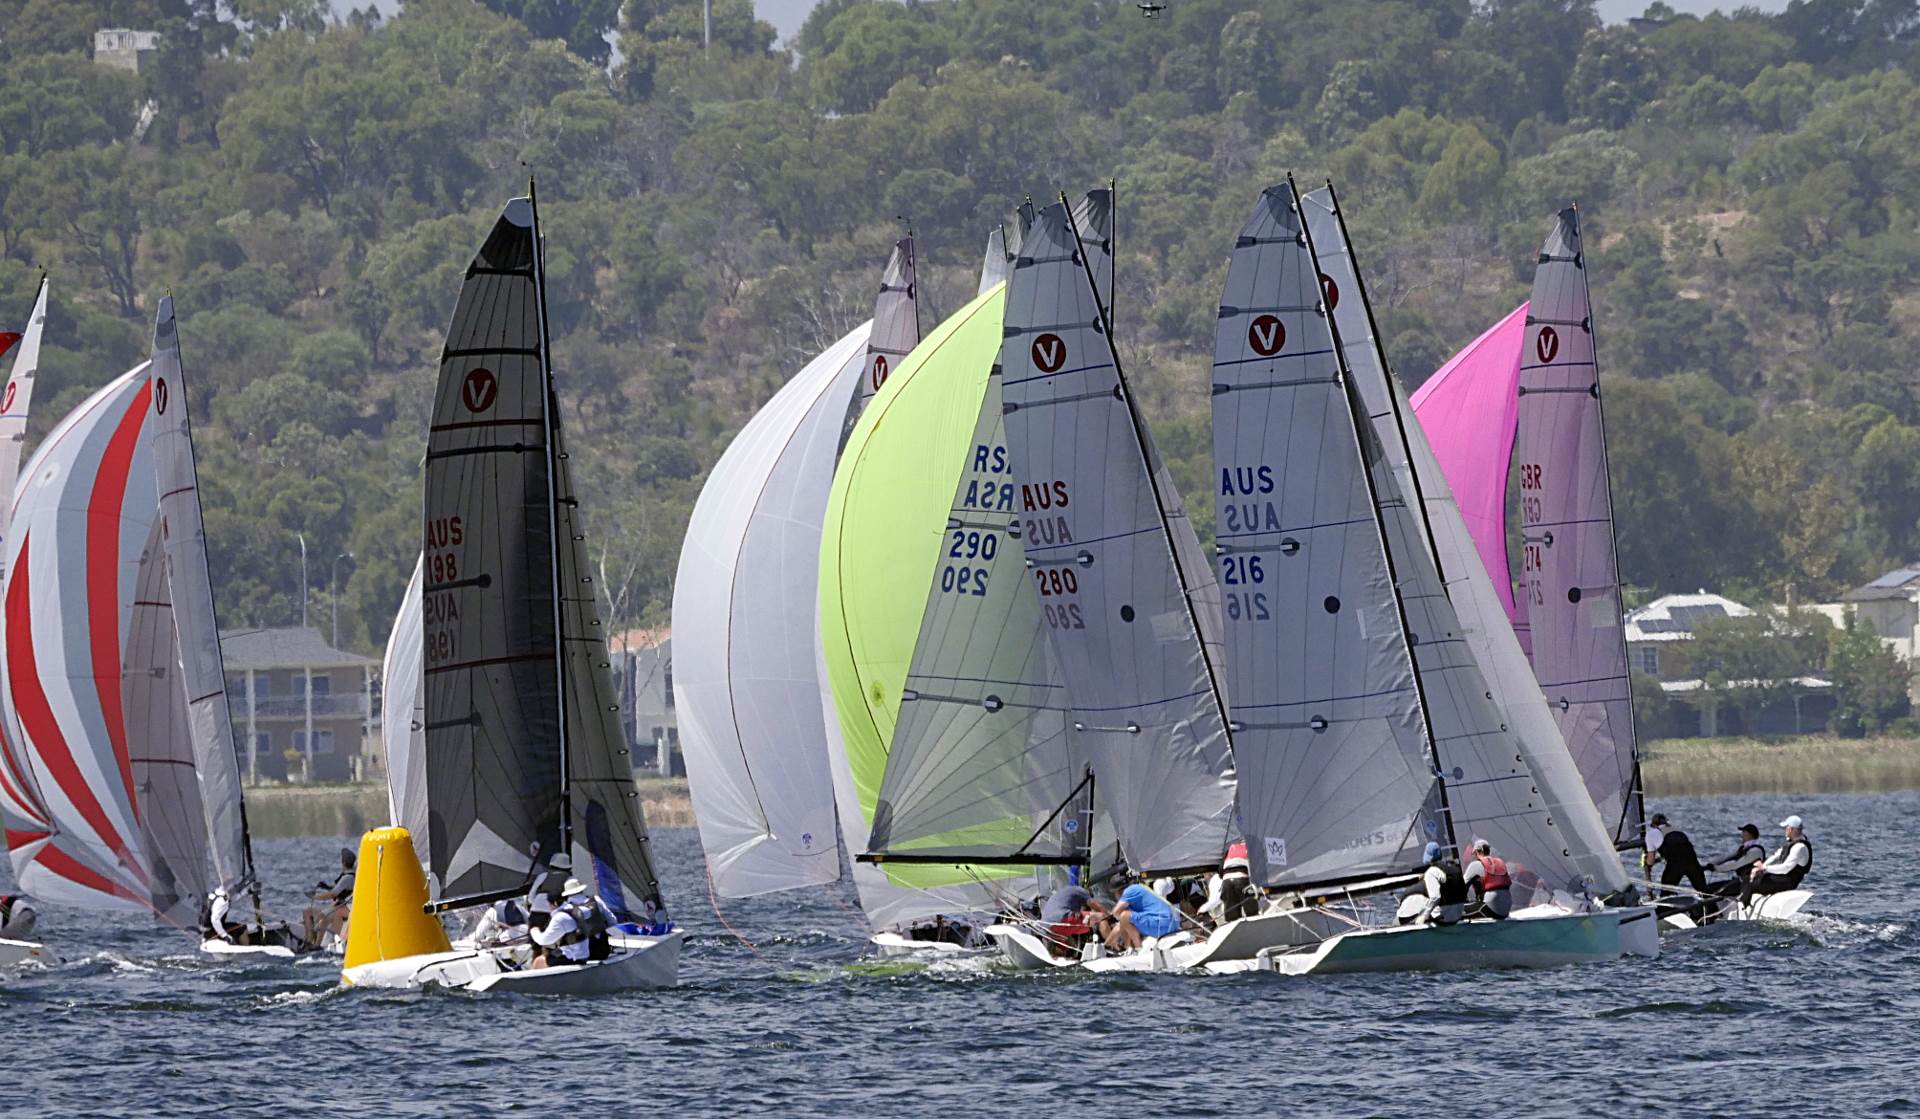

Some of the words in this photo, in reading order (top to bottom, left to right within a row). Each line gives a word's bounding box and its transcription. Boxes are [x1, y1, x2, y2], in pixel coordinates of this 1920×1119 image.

[973, 445, 1012, 474] RS
[1022, 480, 1069, 512] AUS
[1221, 465, 1275, 496] AUS
[427, 516, 463, 550] AUS
[949, 530, 997, 561] 290
[428, 553, 458, 585] 198
[1223, 555, 1264, 586] 216
[1525, 546, 1542, 573] 274
[1036, 568, 1079, 597] 280
